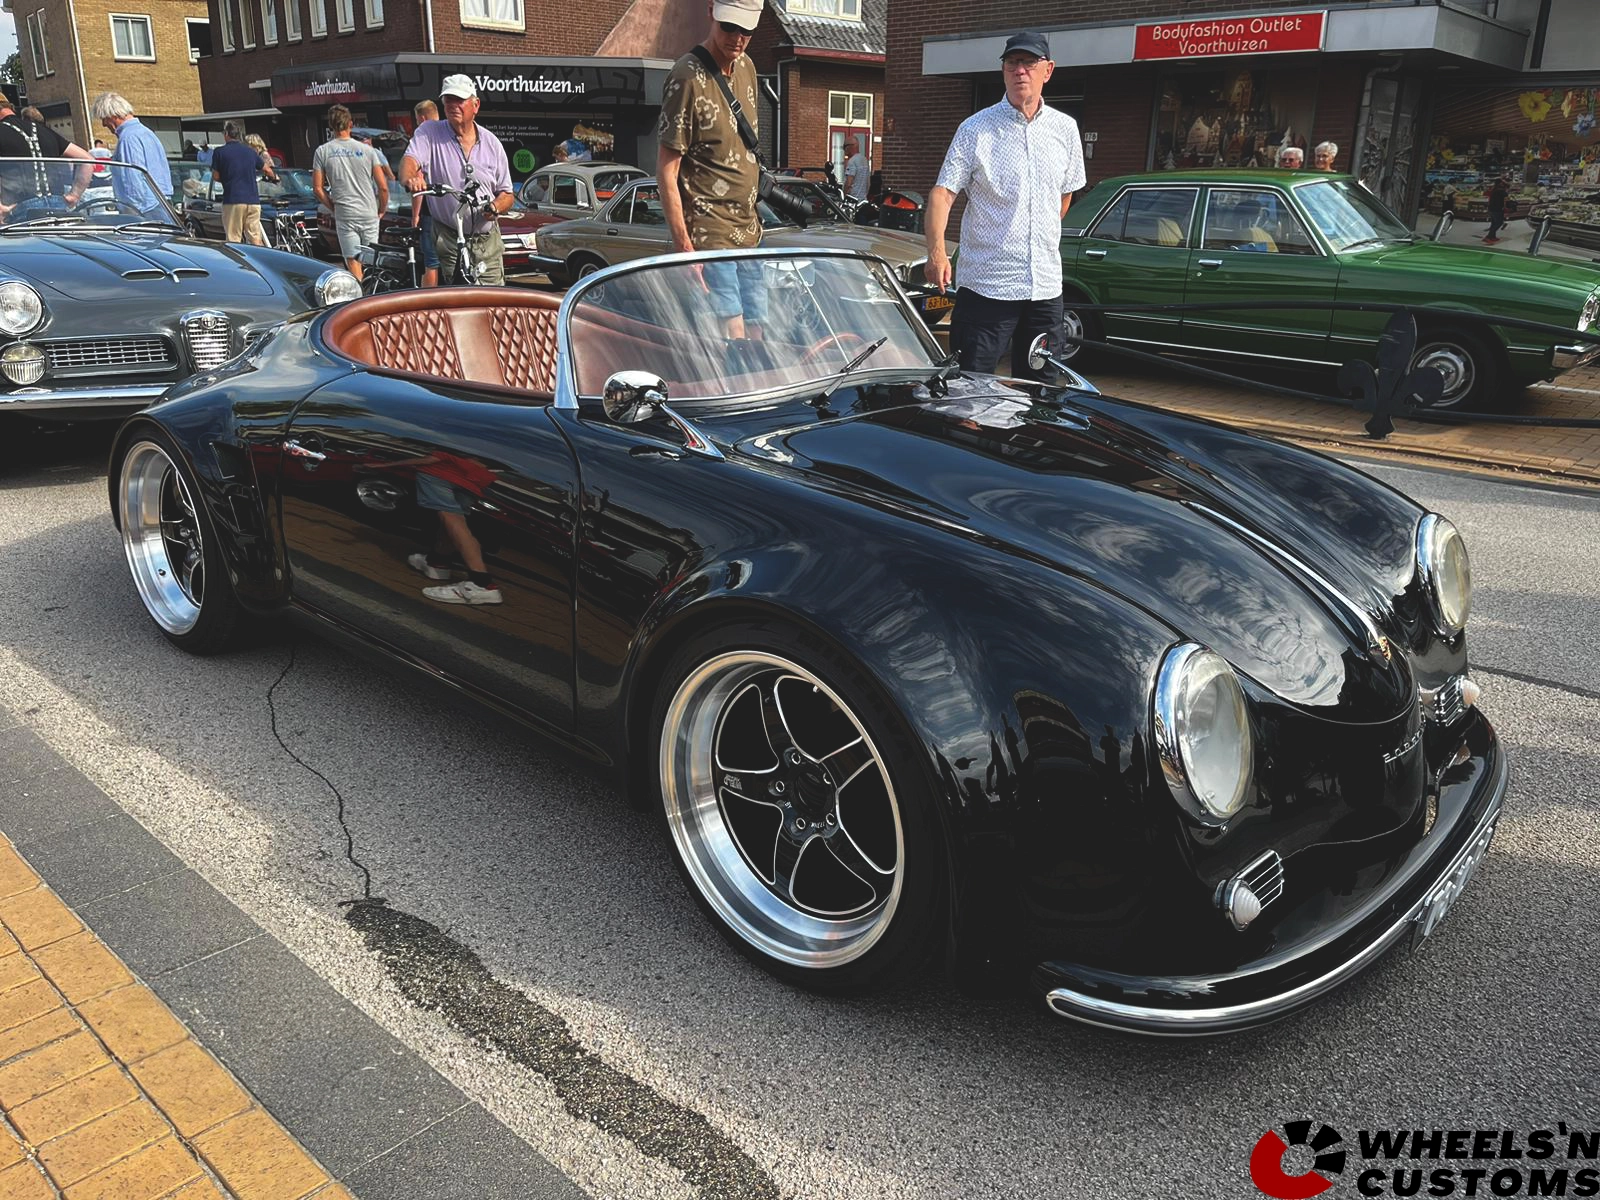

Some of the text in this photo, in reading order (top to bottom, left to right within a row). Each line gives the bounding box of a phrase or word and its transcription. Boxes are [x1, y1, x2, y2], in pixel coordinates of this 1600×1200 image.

[1152, 17, 1302, 41] Bodyfashion Outlet
[1178, 38, 1268, 55] Voorthuizen
